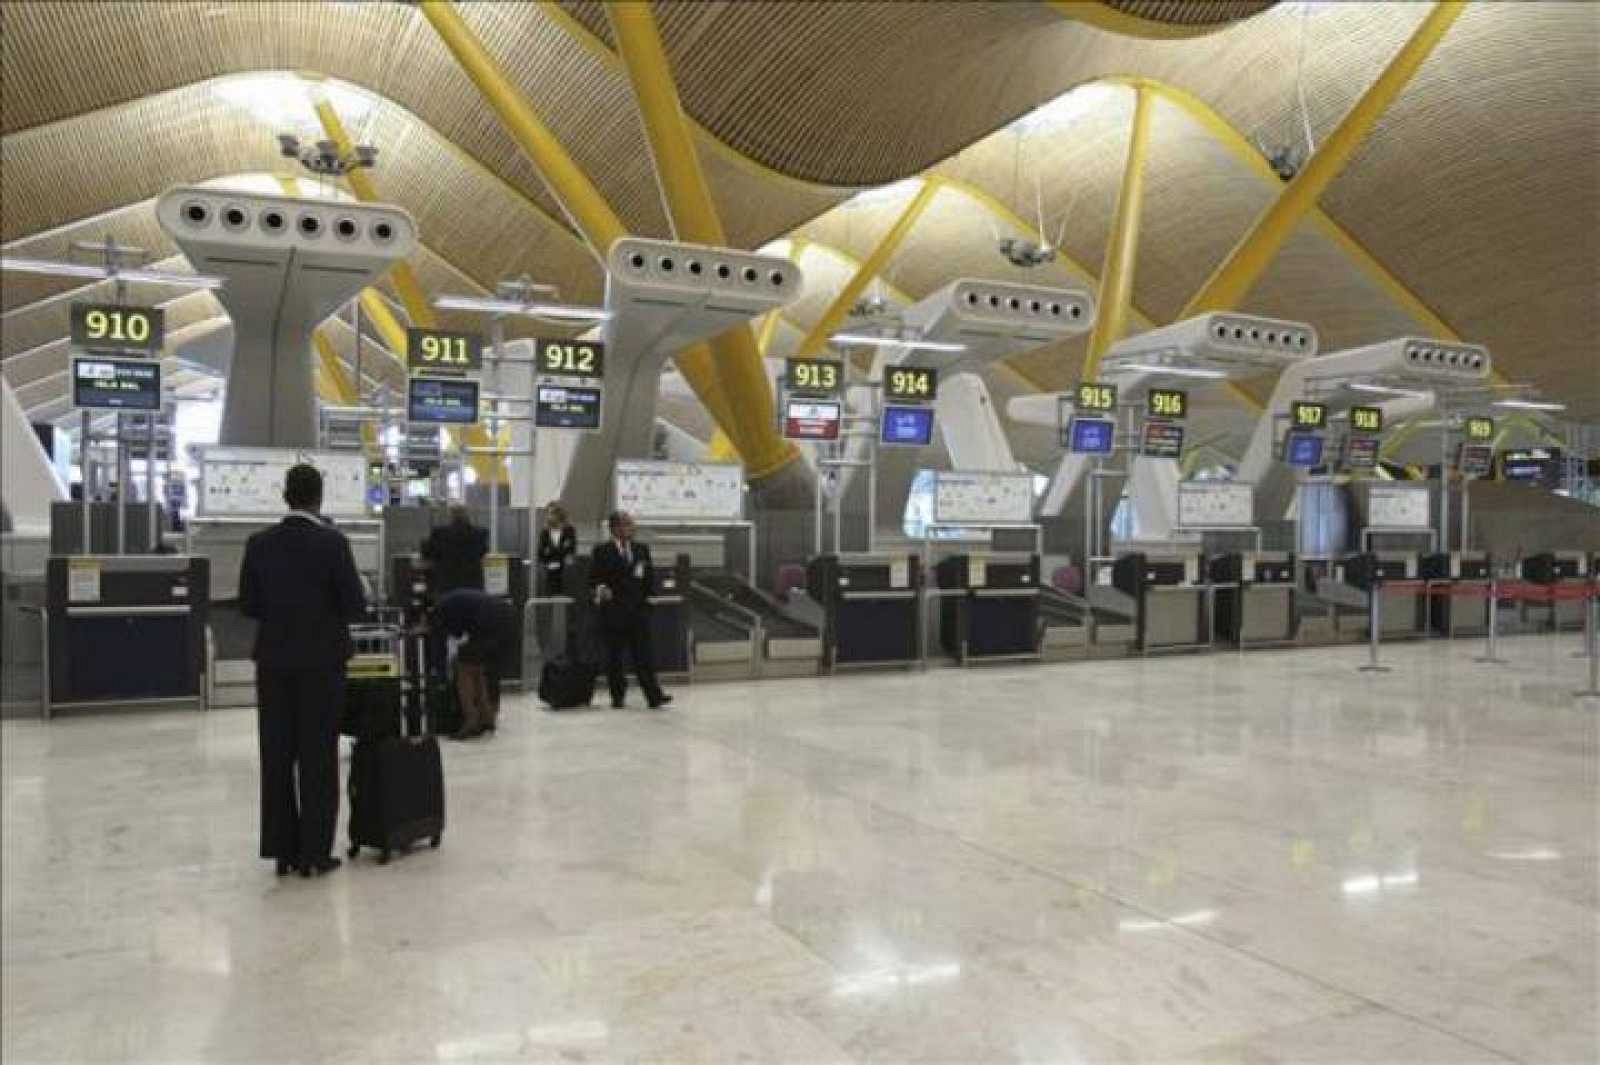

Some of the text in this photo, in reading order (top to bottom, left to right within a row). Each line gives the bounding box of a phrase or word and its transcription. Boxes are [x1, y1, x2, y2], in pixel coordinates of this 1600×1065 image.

[86, 311, 150, 340] 910
[422, 336, 468, 362] 911
[545, 344, 594, 371] 912
[795, 363, 836, 388] 913
[891, 371, 928, 395] 914
[1081, 387, 1112, 409] 915
[1152, 393, 1181, 414] 916
